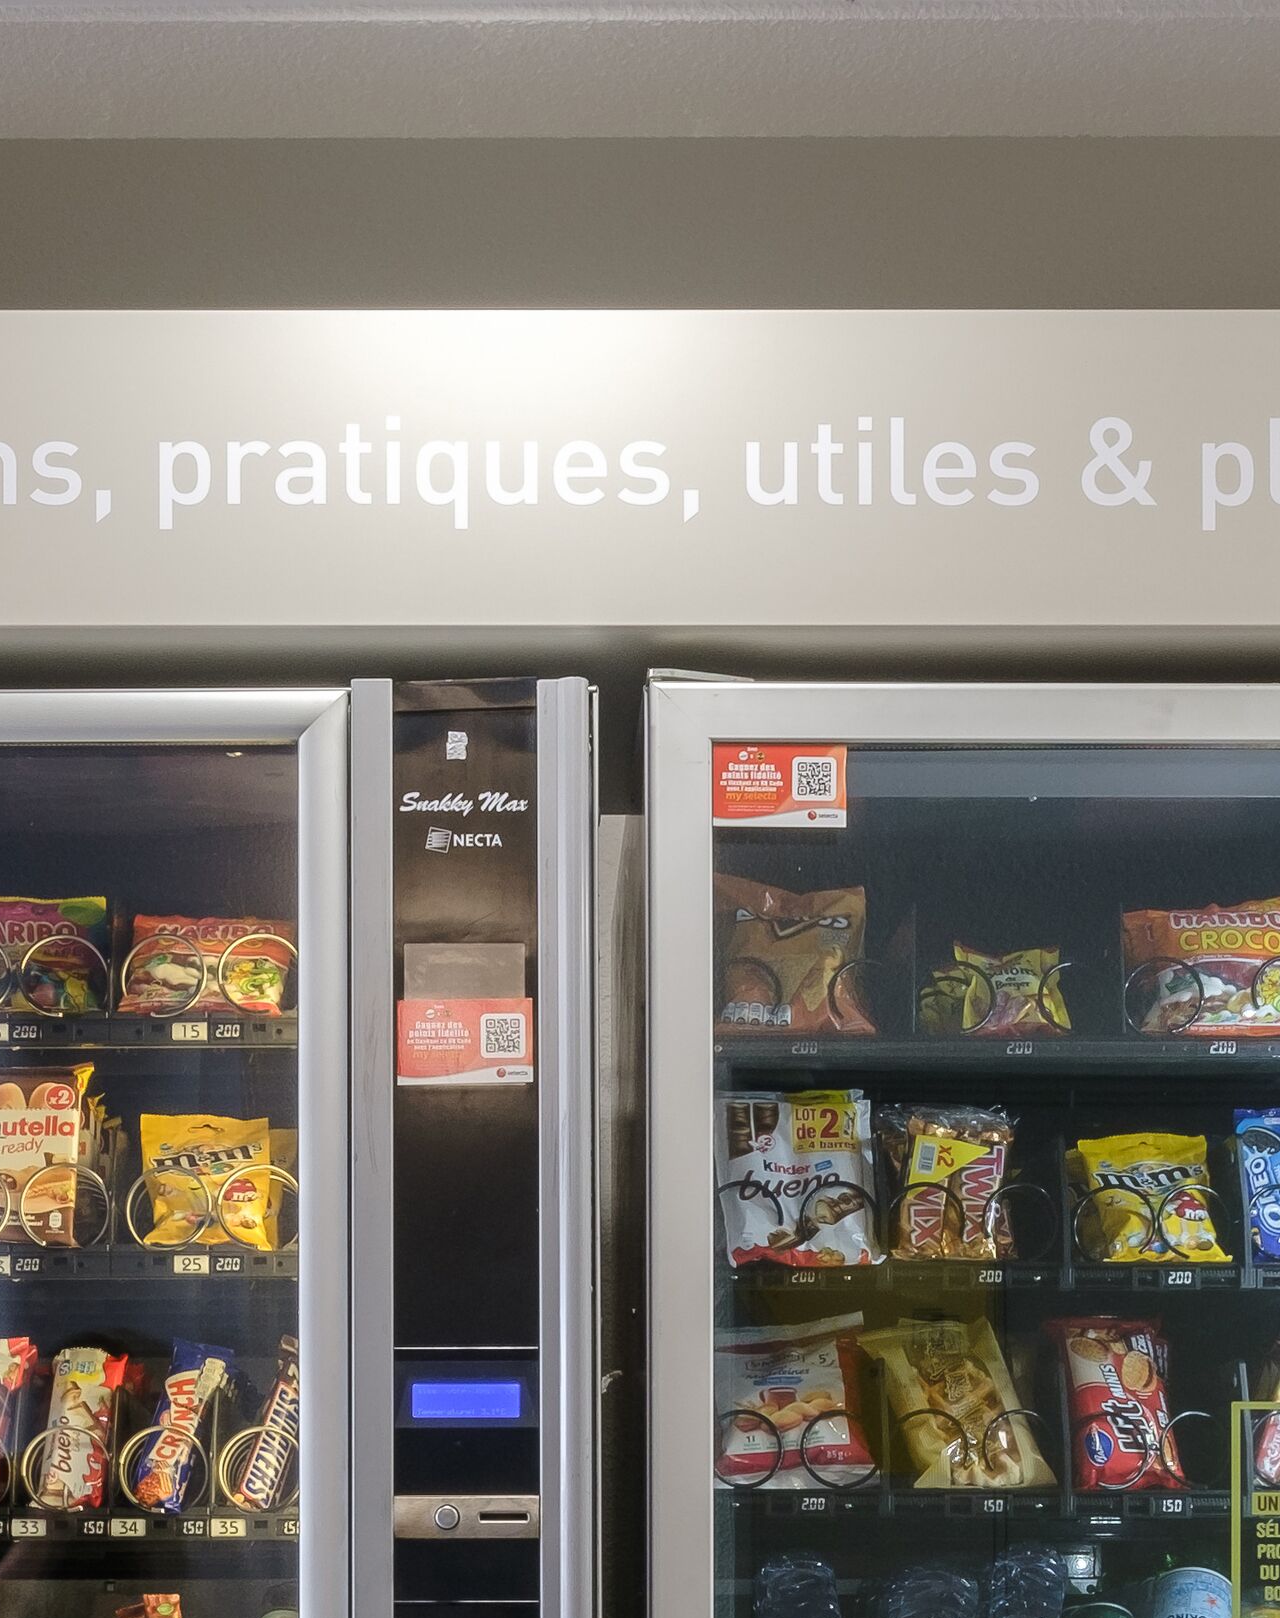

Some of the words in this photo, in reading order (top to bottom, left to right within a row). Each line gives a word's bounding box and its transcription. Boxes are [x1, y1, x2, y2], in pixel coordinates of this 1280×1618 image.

[158, 415, 699, 529] pratiques,
[745, 416, 1040, 506] utiles
[1081, 416, 1157, 507] &
[398, 791, 475, 817] Snakky
[477, 791, 529, 813] Max
[453, 832, 503, 847] NECTA
[182, 1024, 200, 1038] 15
[795, 1107, 816, 1122] LOT
[796, 1122, 817, 1139] de
[819, 1107, 840, 1138] 2
[819, 1141, 858, 1150] barres
[739, 1169, 841, 1201] bueno
[961, 1145, 1005, 1244] TWIX
[181, 1257, 202, 1272] 25
[1099, 1363, 1127, 1399] MINIS
[20, 1522, 39, 1535] 33
[119, 1522, 139, 1535] 34
[219, 1522, 239, 1535] 35
[1260, 1564, 1280, 1580] DU
